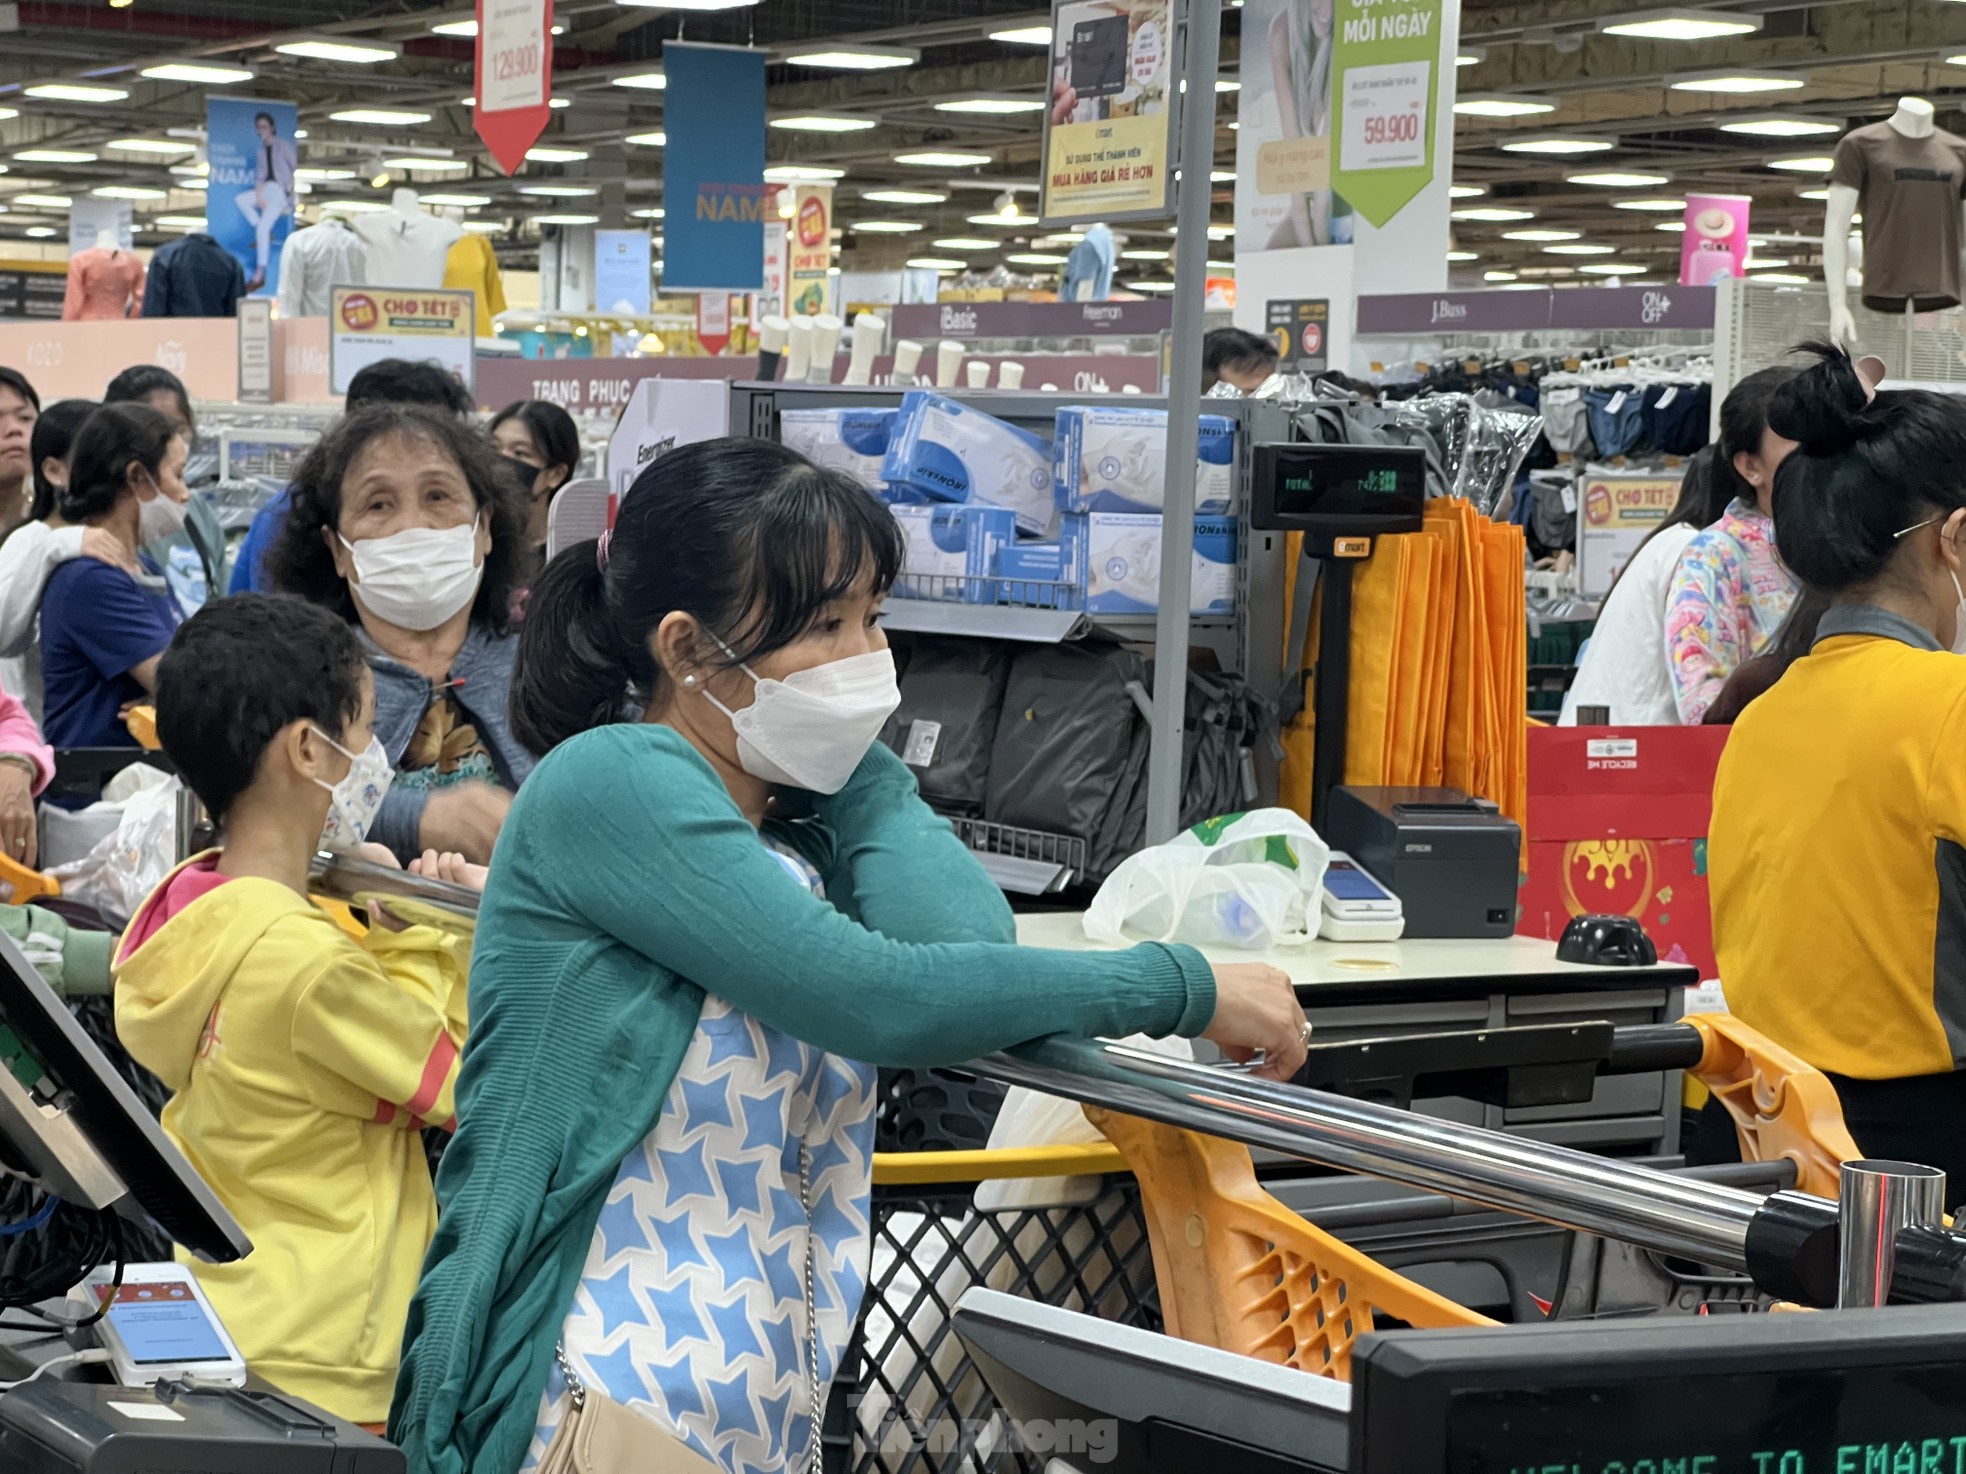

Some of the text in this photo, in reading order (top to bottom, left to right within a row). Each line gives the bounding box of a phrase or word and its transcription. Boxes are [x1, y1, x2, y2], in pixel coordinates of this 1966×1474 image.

[1343, 7, 1432, 44] MỖI NGÀY
[1365, 113, 1418, 144] 59.900
[210, 167, 255, 185] NAM
[1052, 173, 1071, 187] MUA
[1100, 165, 1115, 183] GIÁ
[696, 194, 764, 222] NAM
[532, 379, 580, 404] TRANG
[1405, 844, 1432, 852] EPSON
